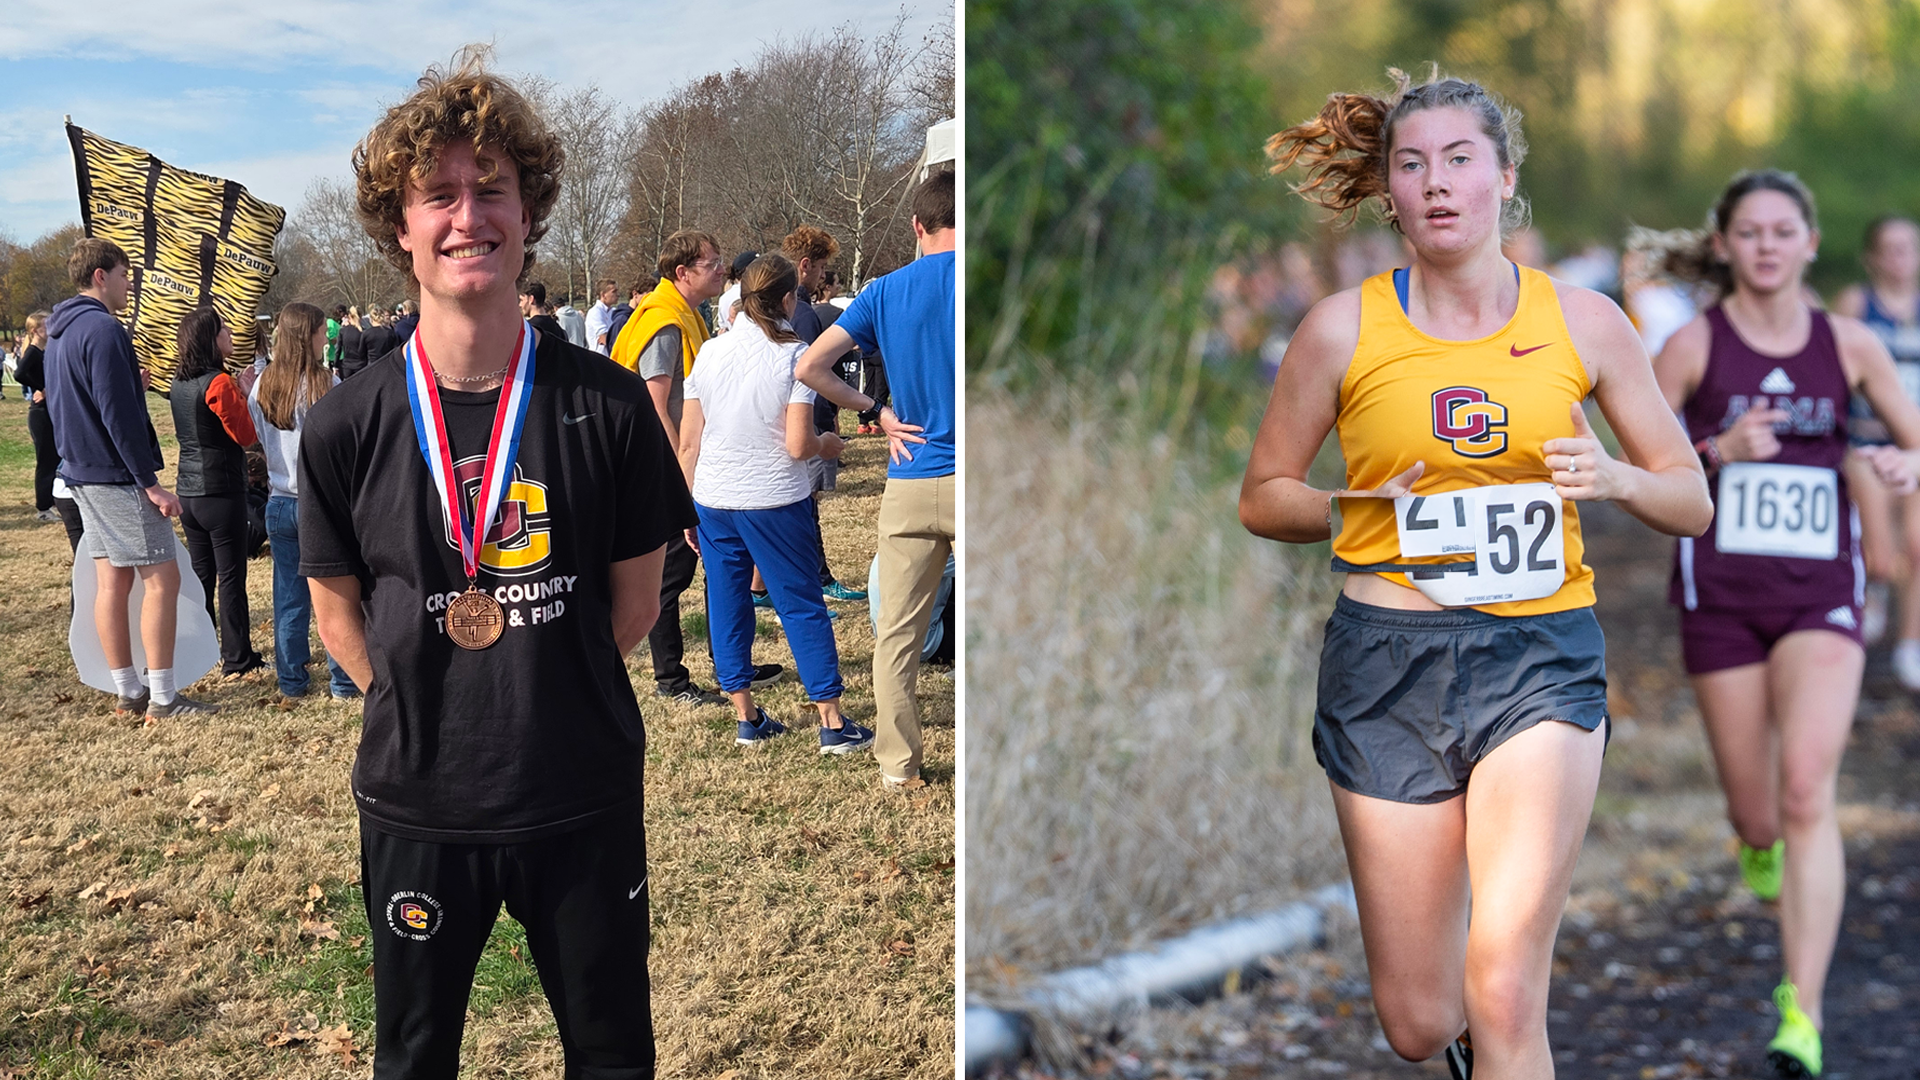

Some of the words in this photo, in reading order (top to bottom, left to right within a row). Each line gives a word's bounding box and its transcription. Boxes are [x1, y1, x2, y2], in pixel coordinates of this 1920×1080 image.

[96, 202, 139, 221] DePauw
[223, 247, 272, 274] DePauw
[149, 272, 195, 296] DePauw
[1733, 480, 1831, 534] 1630
[426, 587, 487, 613] CRO
[494, 575, 578, 604] COUNRY
[508, 608, 526, 627] &
[530, 599, 565, 625] FIELD
[391, 890, 415, 902] OBERLIN
[416, 891, 441, 909] COLLEGE
[386, 901, 394, 921] TRACK
[391, 926, 408, 938] FIELD
[411, 933, 431, 941] CROSS
[430, 909, 444, 935] COUNTRY
